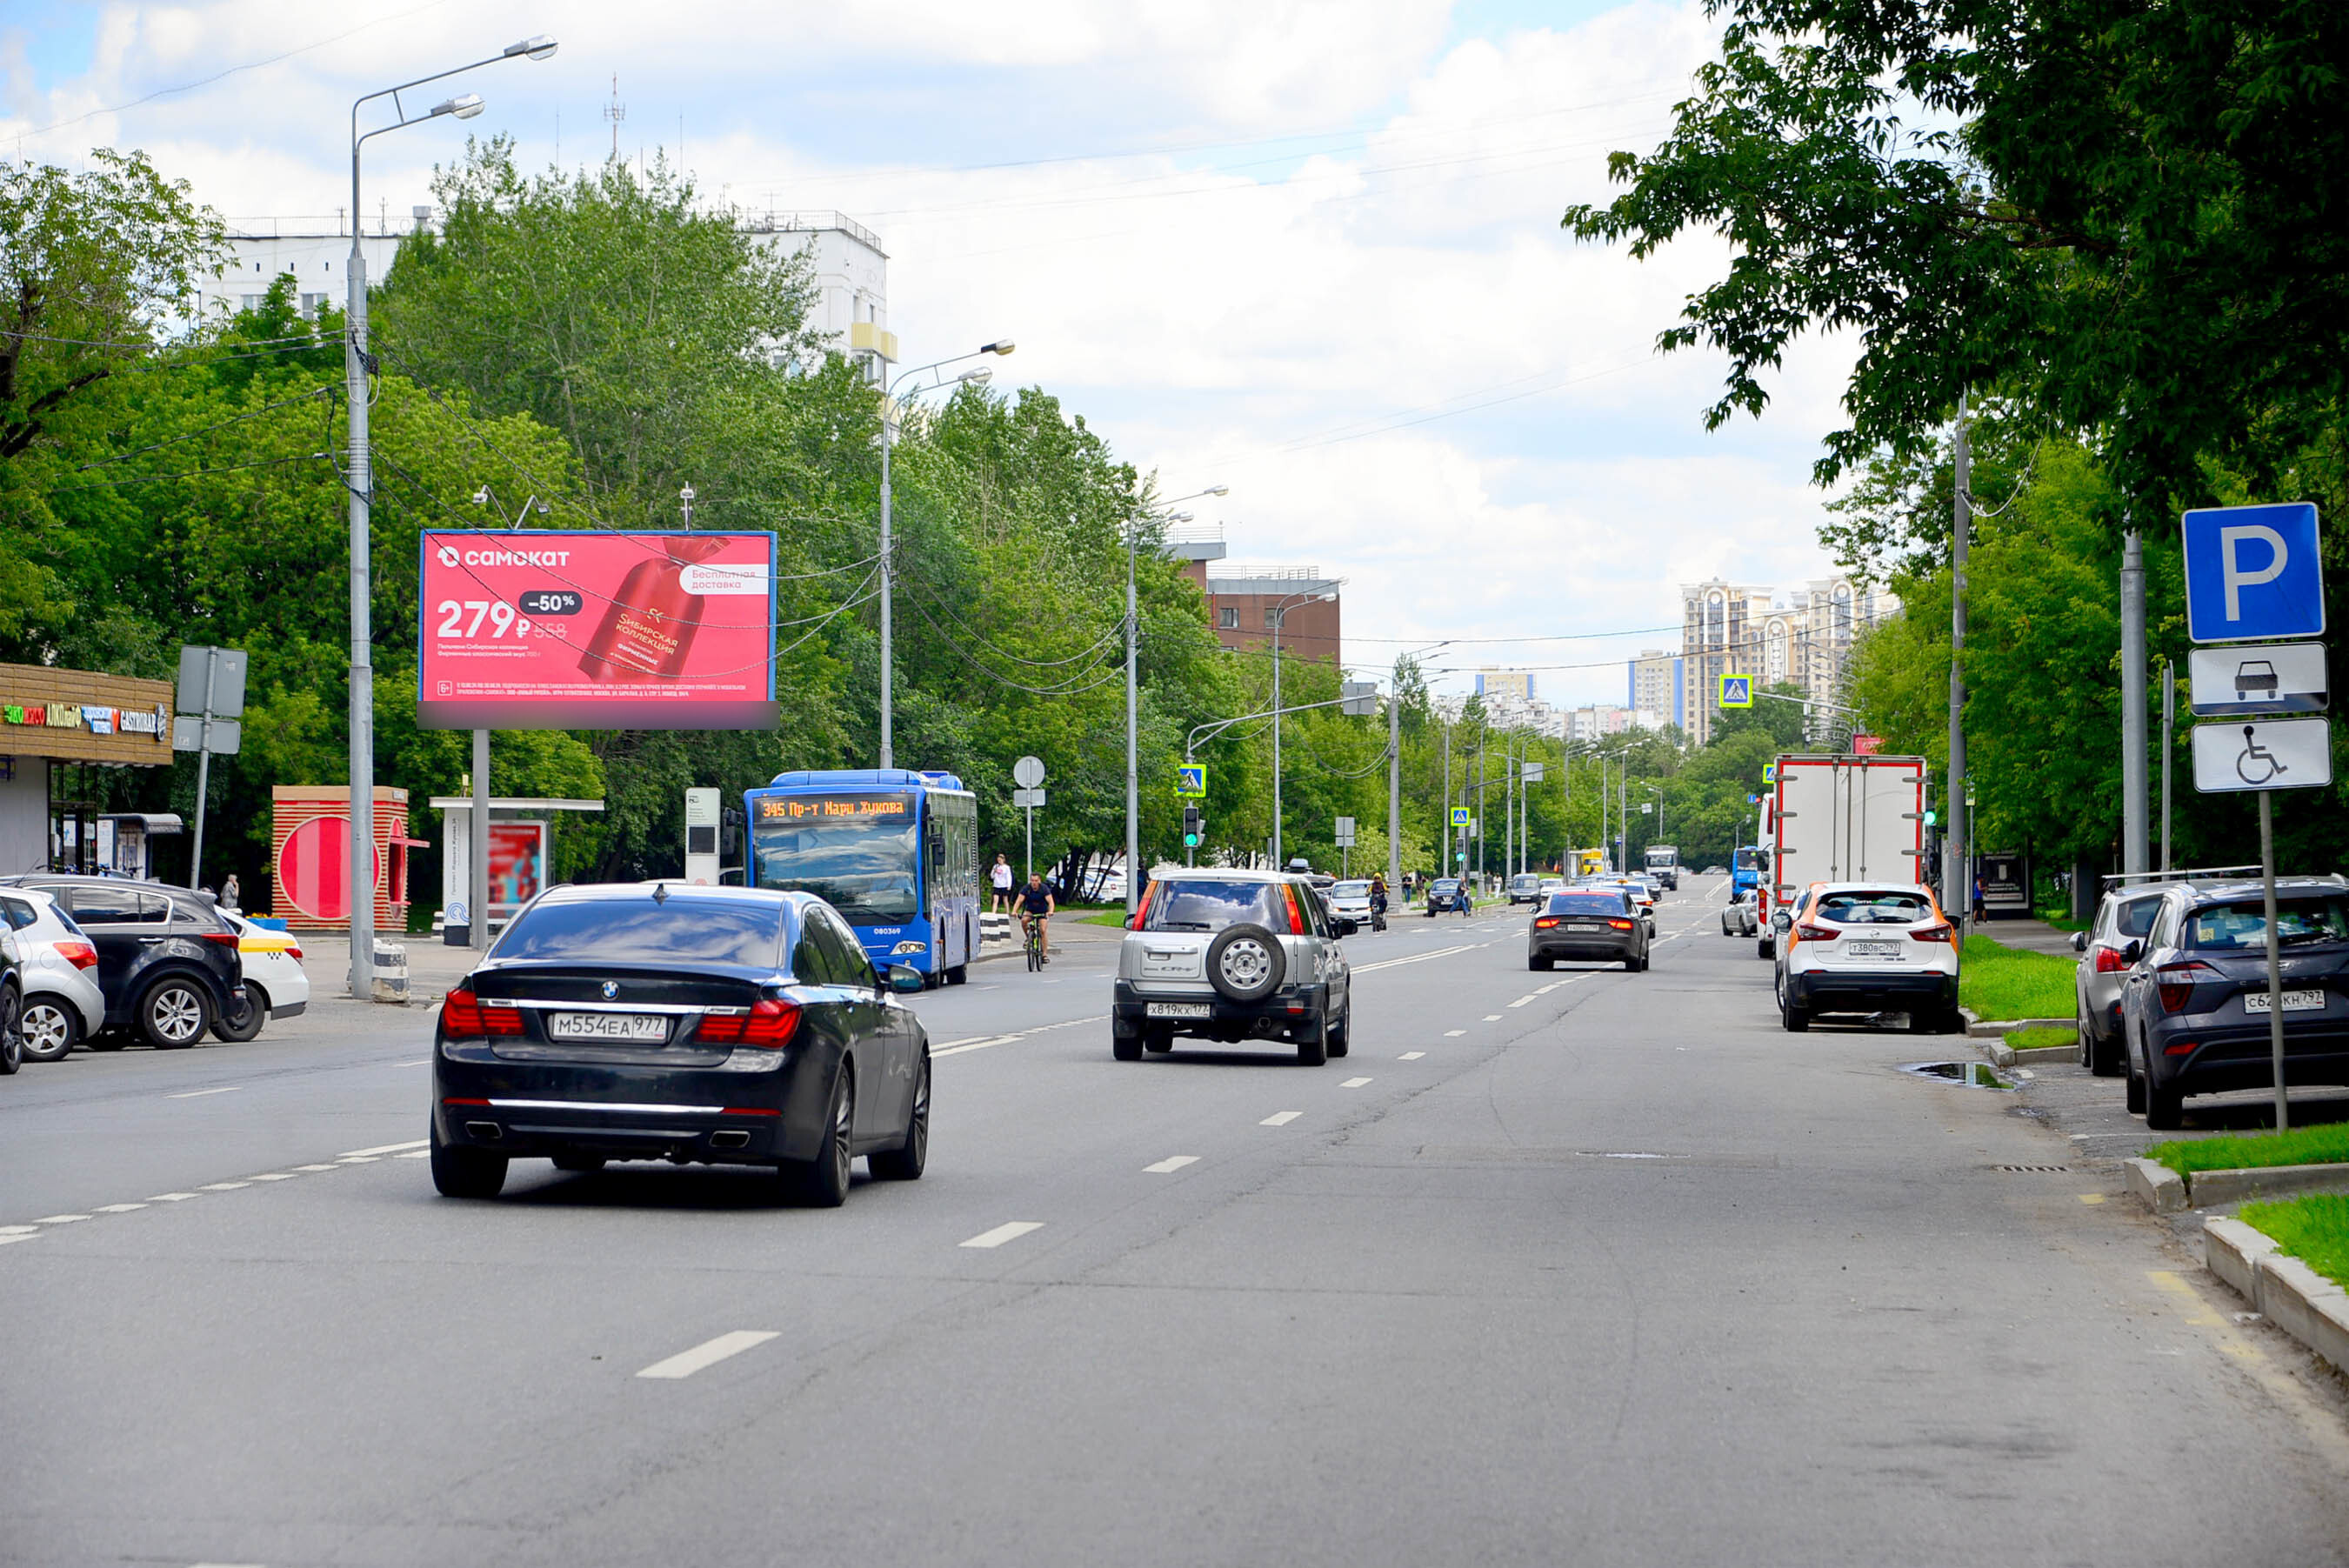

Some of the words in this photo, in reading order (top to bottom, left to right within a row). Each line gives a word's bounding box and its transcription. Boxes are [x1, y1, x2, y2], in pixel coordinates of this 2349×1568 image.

[692, 569, 756, 579] Бесплатная
[692, 581, 742, 590] доставка
[532, 623, 567, 639] 558
[615, 623, 676, 655] КОЛЛЕКЦИЯ
[120, 709, 157, 733] GASTROBAR
[763, 802, 785, 817] 345
[788, 802, 819, 818] Пр-т
